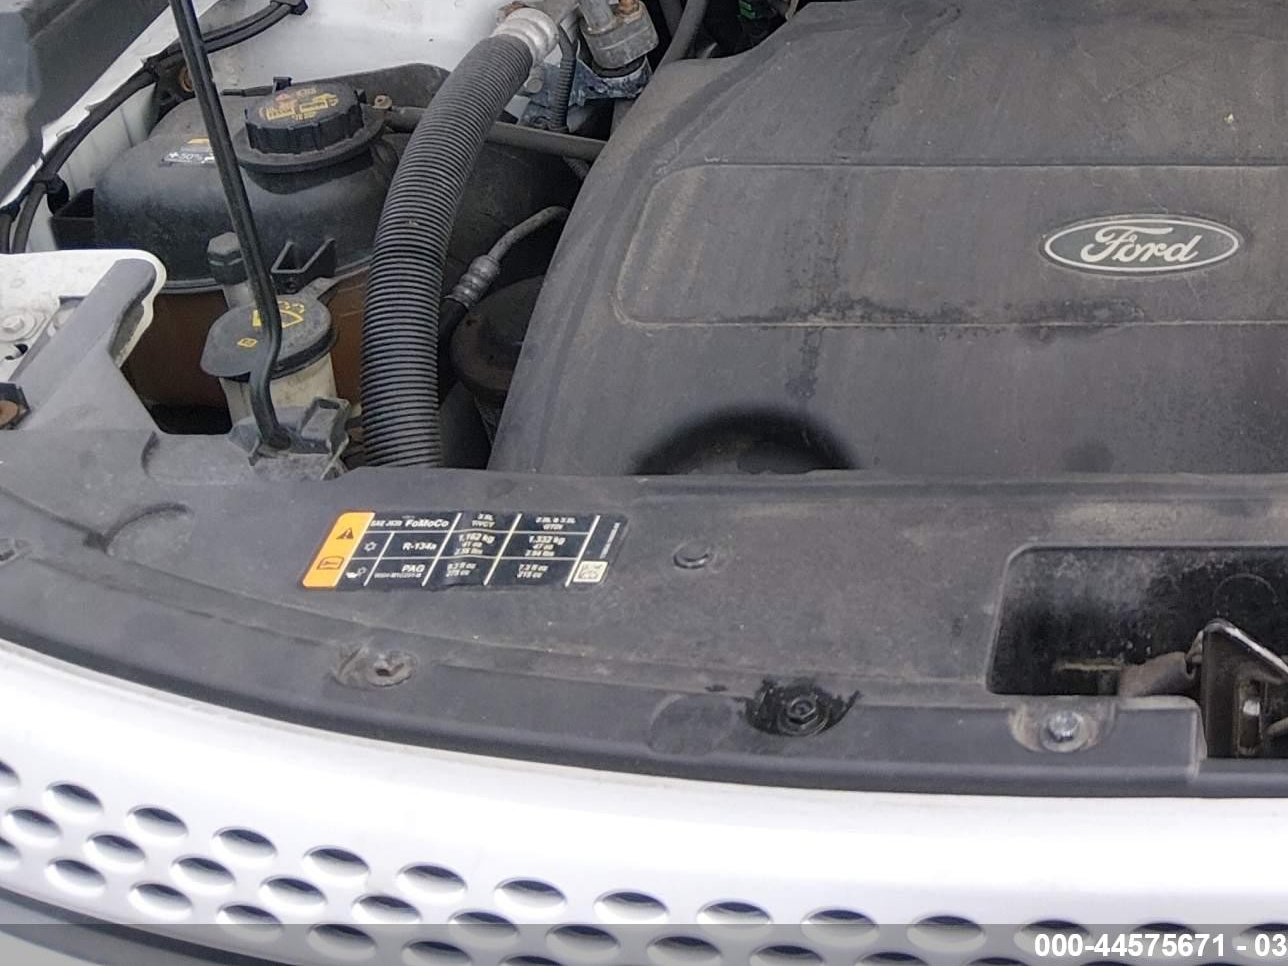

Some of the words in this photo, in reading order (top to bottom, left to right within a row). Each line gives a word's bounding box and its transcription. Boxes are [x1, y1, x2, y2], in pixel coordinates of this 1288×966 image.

[1080, 225, 1202, 263] Ford
[404, 519, 449, 528] FoMoCo
[402, 542, 438, 551] R-134a
[401, 564, 426, 573] PAG
